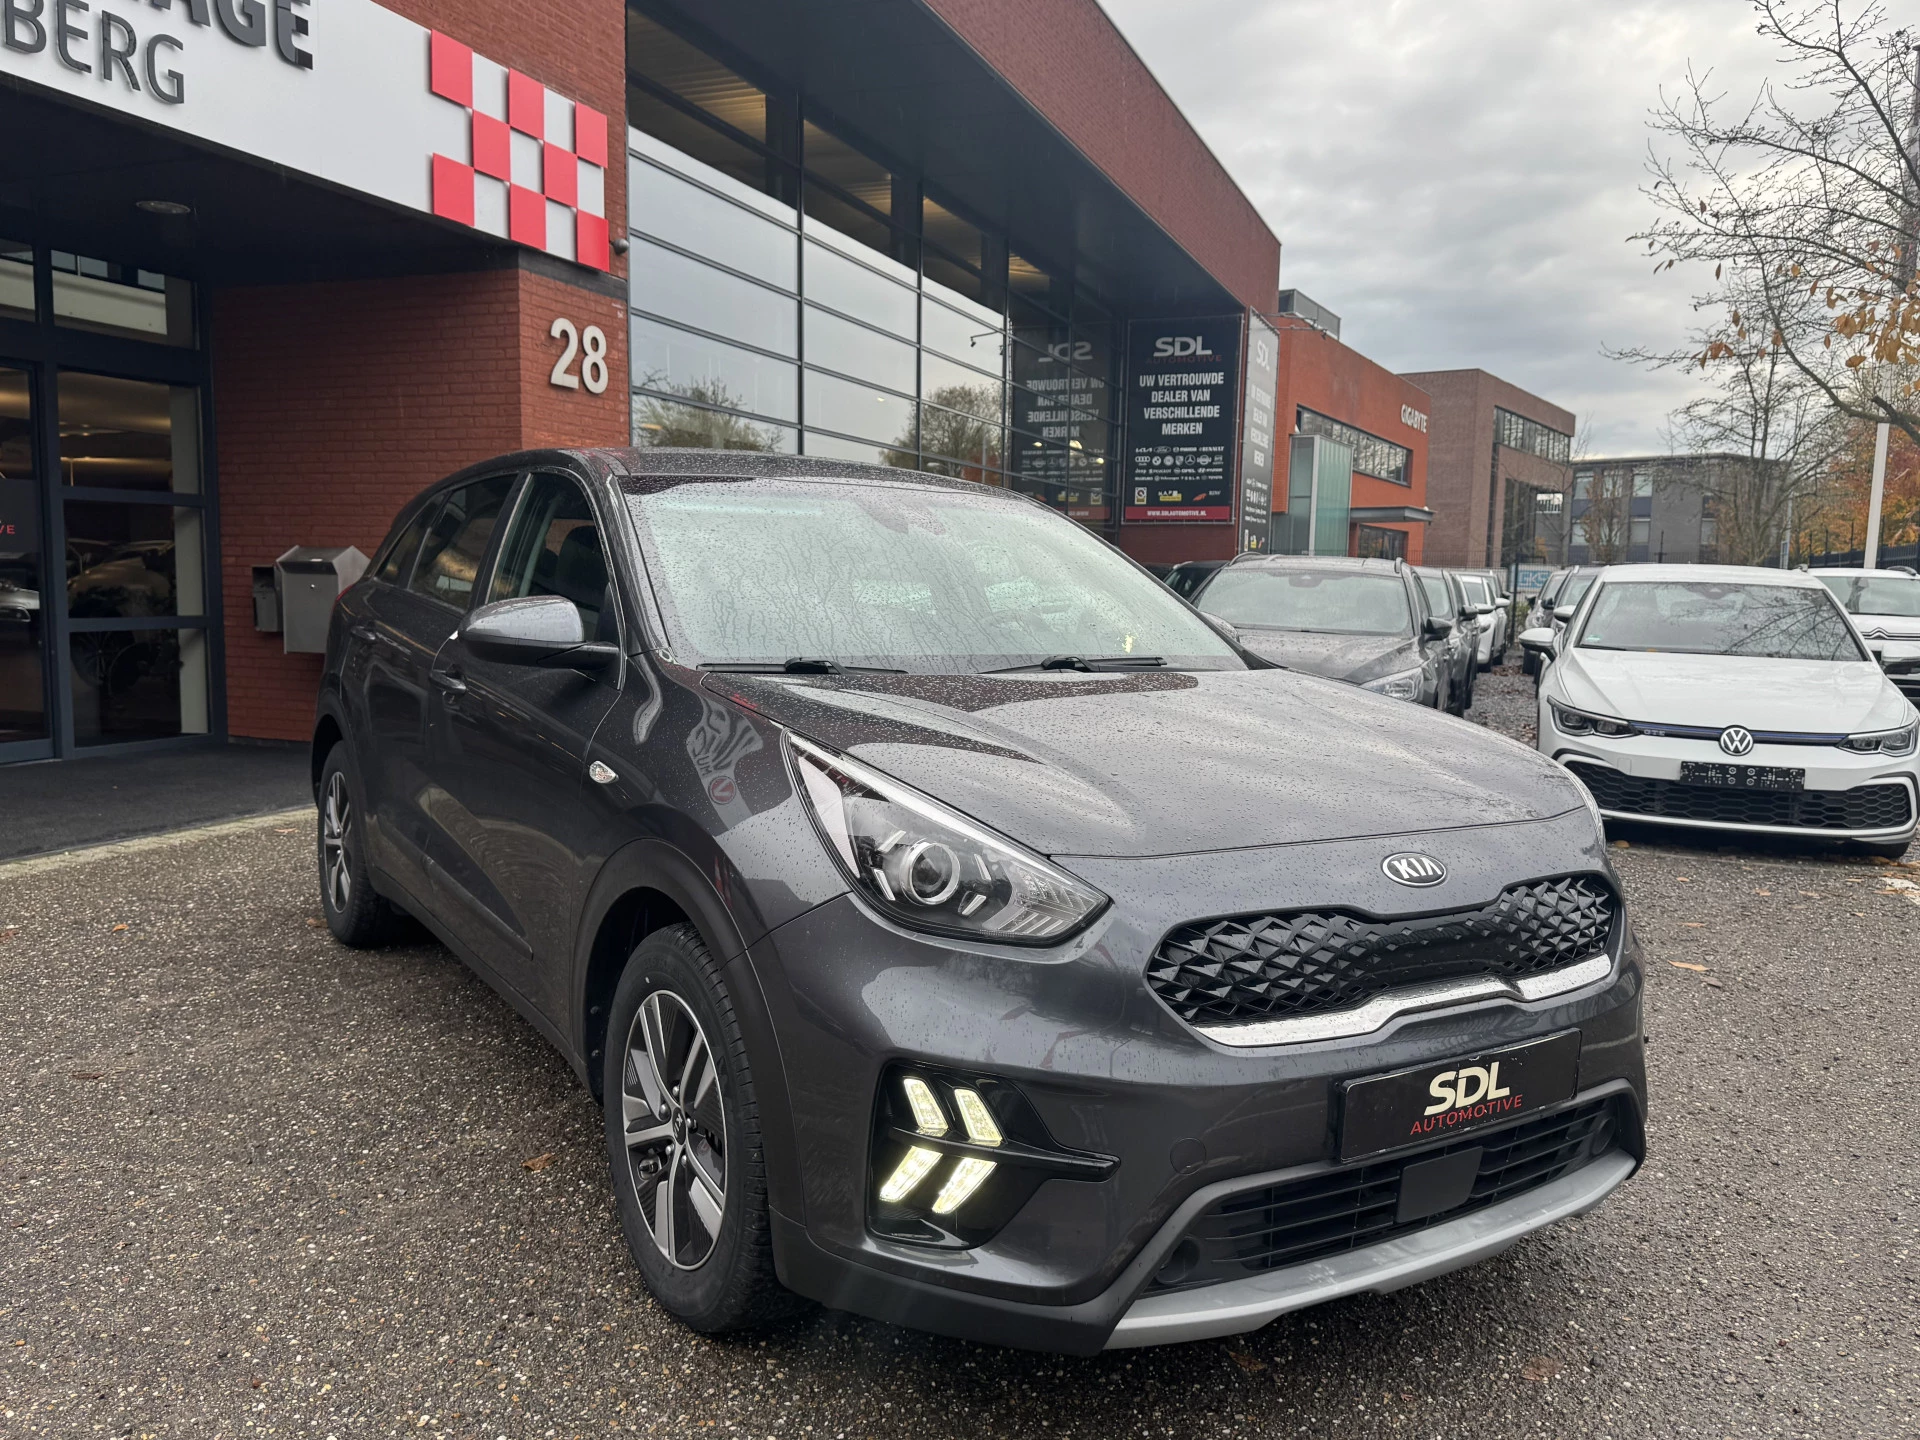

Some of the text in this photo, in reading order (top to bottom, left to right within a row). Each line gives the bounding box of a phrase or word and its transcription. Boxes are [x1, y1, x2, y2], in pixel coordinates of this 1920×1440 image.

[4, 0, 184, 104] BERG
[550, 317, 609, 394] 28
[1153, 335, 1213, 357] SDL
[1140, 372, 1224, 387] UW VERTROUWDE
[1151, 389, 1210, 403] DEALER VAN
[1144, 405, 1220, 419] VERSCHILLENDE
[1401, 403, 1428, 434] GIGABYTE
[1162, 422, 1202, 435] MERKEN
[1391, 857, 1443, 879] KIA
[1423, 1061, 1511, 1116] SDL
[1410, 1094, 1524, 1136] AUTOMOTIVE
